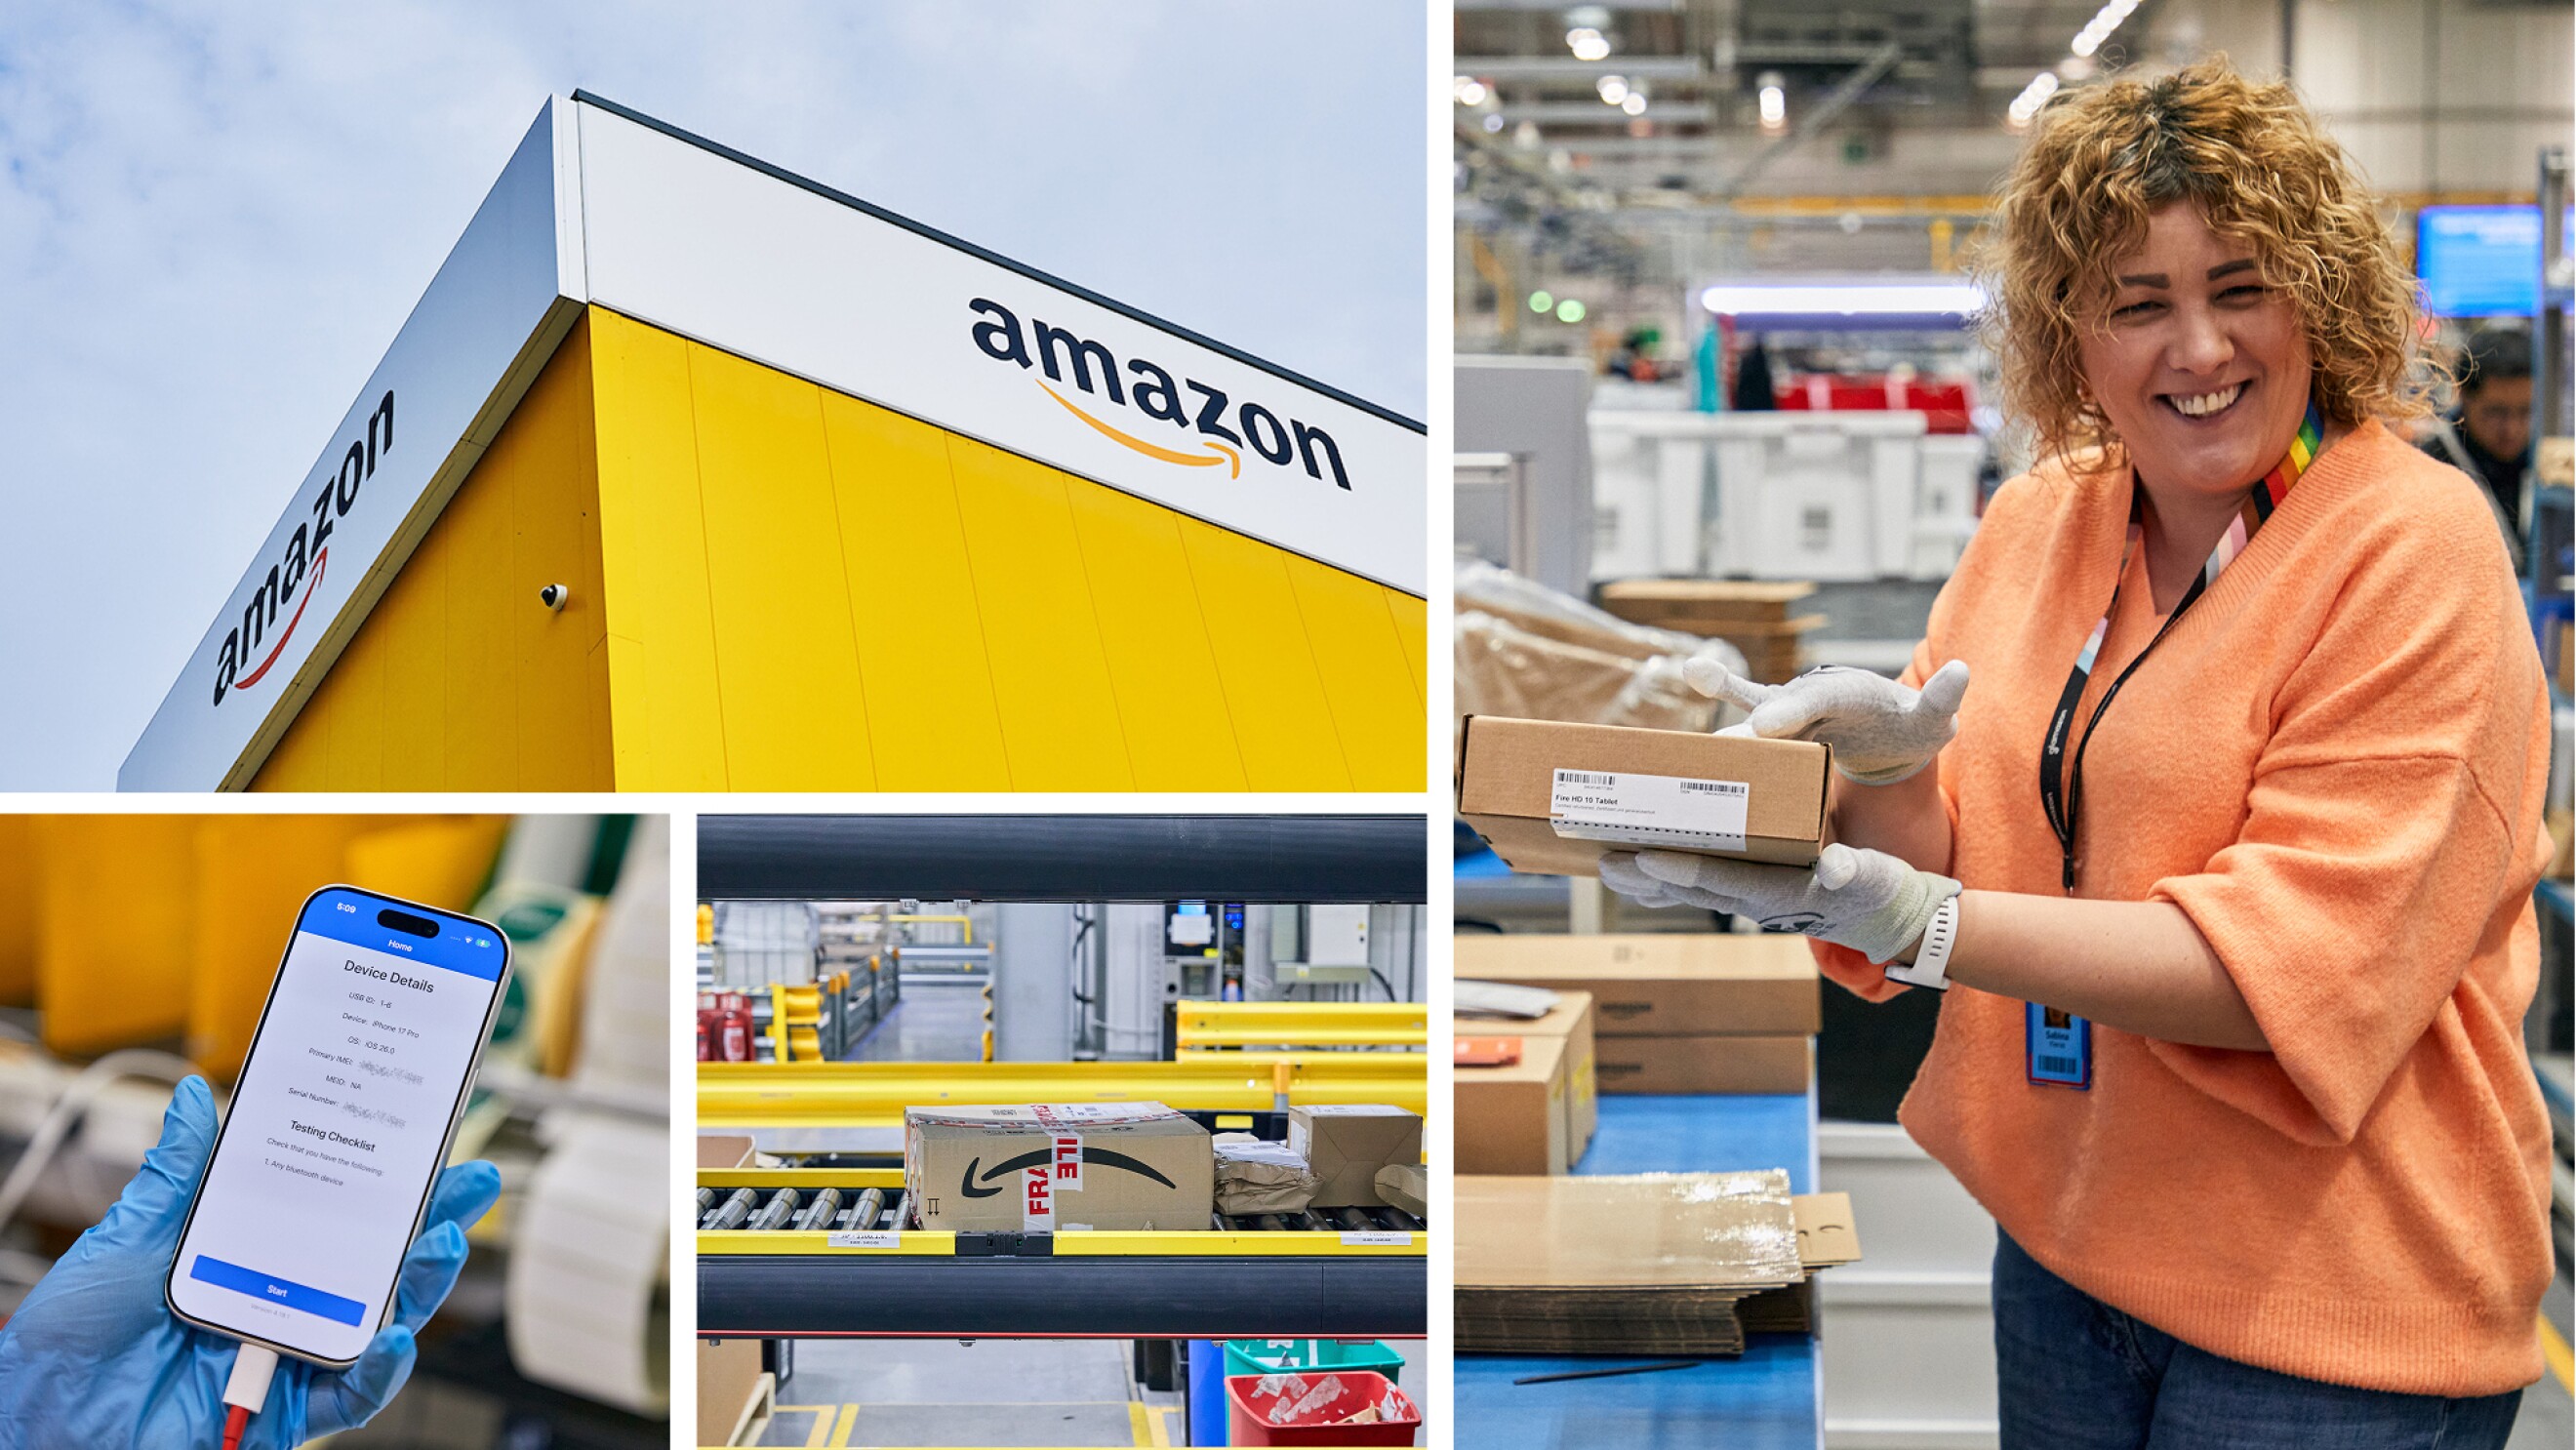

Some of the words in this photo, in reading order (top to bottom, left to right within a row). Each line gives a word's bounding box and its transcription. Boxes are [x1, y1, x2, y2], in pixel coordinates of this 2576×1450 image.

[969, 298, 1352, 491] amazon
[214, 389, 394, 707] amazon
[337, 902, 357, 913] 5:09
[387, 939, 414, 952] Home
[344, 959, 387, 981] Device
[390, 971, 435, 993] Details
[348, 991, 365, 1001] USB
[366, 995, 376, 1004] ID:
[342, 1012, 368, 1025] Device:
[372, 1020, 396, 1032] iPhone
[407, 1029, 420, 1038] Pro
[347, 1035, 360, 1045] OS:
[364, 1040, 378, 1050] iOS
[379, 1044, 395, 1054] 26.0
[308, 1047, 335, 1062] Primary
[336, 1055, 353, 1066] IMEI:
[325, 1074, 345, 1086] MEID:
[350, 1081, 362, 1090] NA
[288, 1087, 308, 1099] Serial
[308, 1093, 339, 1107] Number:
[290, 1119, 327, 1140] Testing
[328, 1131, 376, 1152] Checklist
[266, 1137, 289, 1149] Check
[290, 1144, 305, 1154] that
[305, 1149, 318, 1158] you
[319, 1151, 338, 1163] have
[338, 1156, 350, 1166] the
[351, 1161, 384, 1177] following:
[270, 1159, 285, 1171] Any
[286, 1164, 320, 1180] bluetooth
[320, 1174, 343, 1187] device
[267, 1284, 288, 1298] Start
